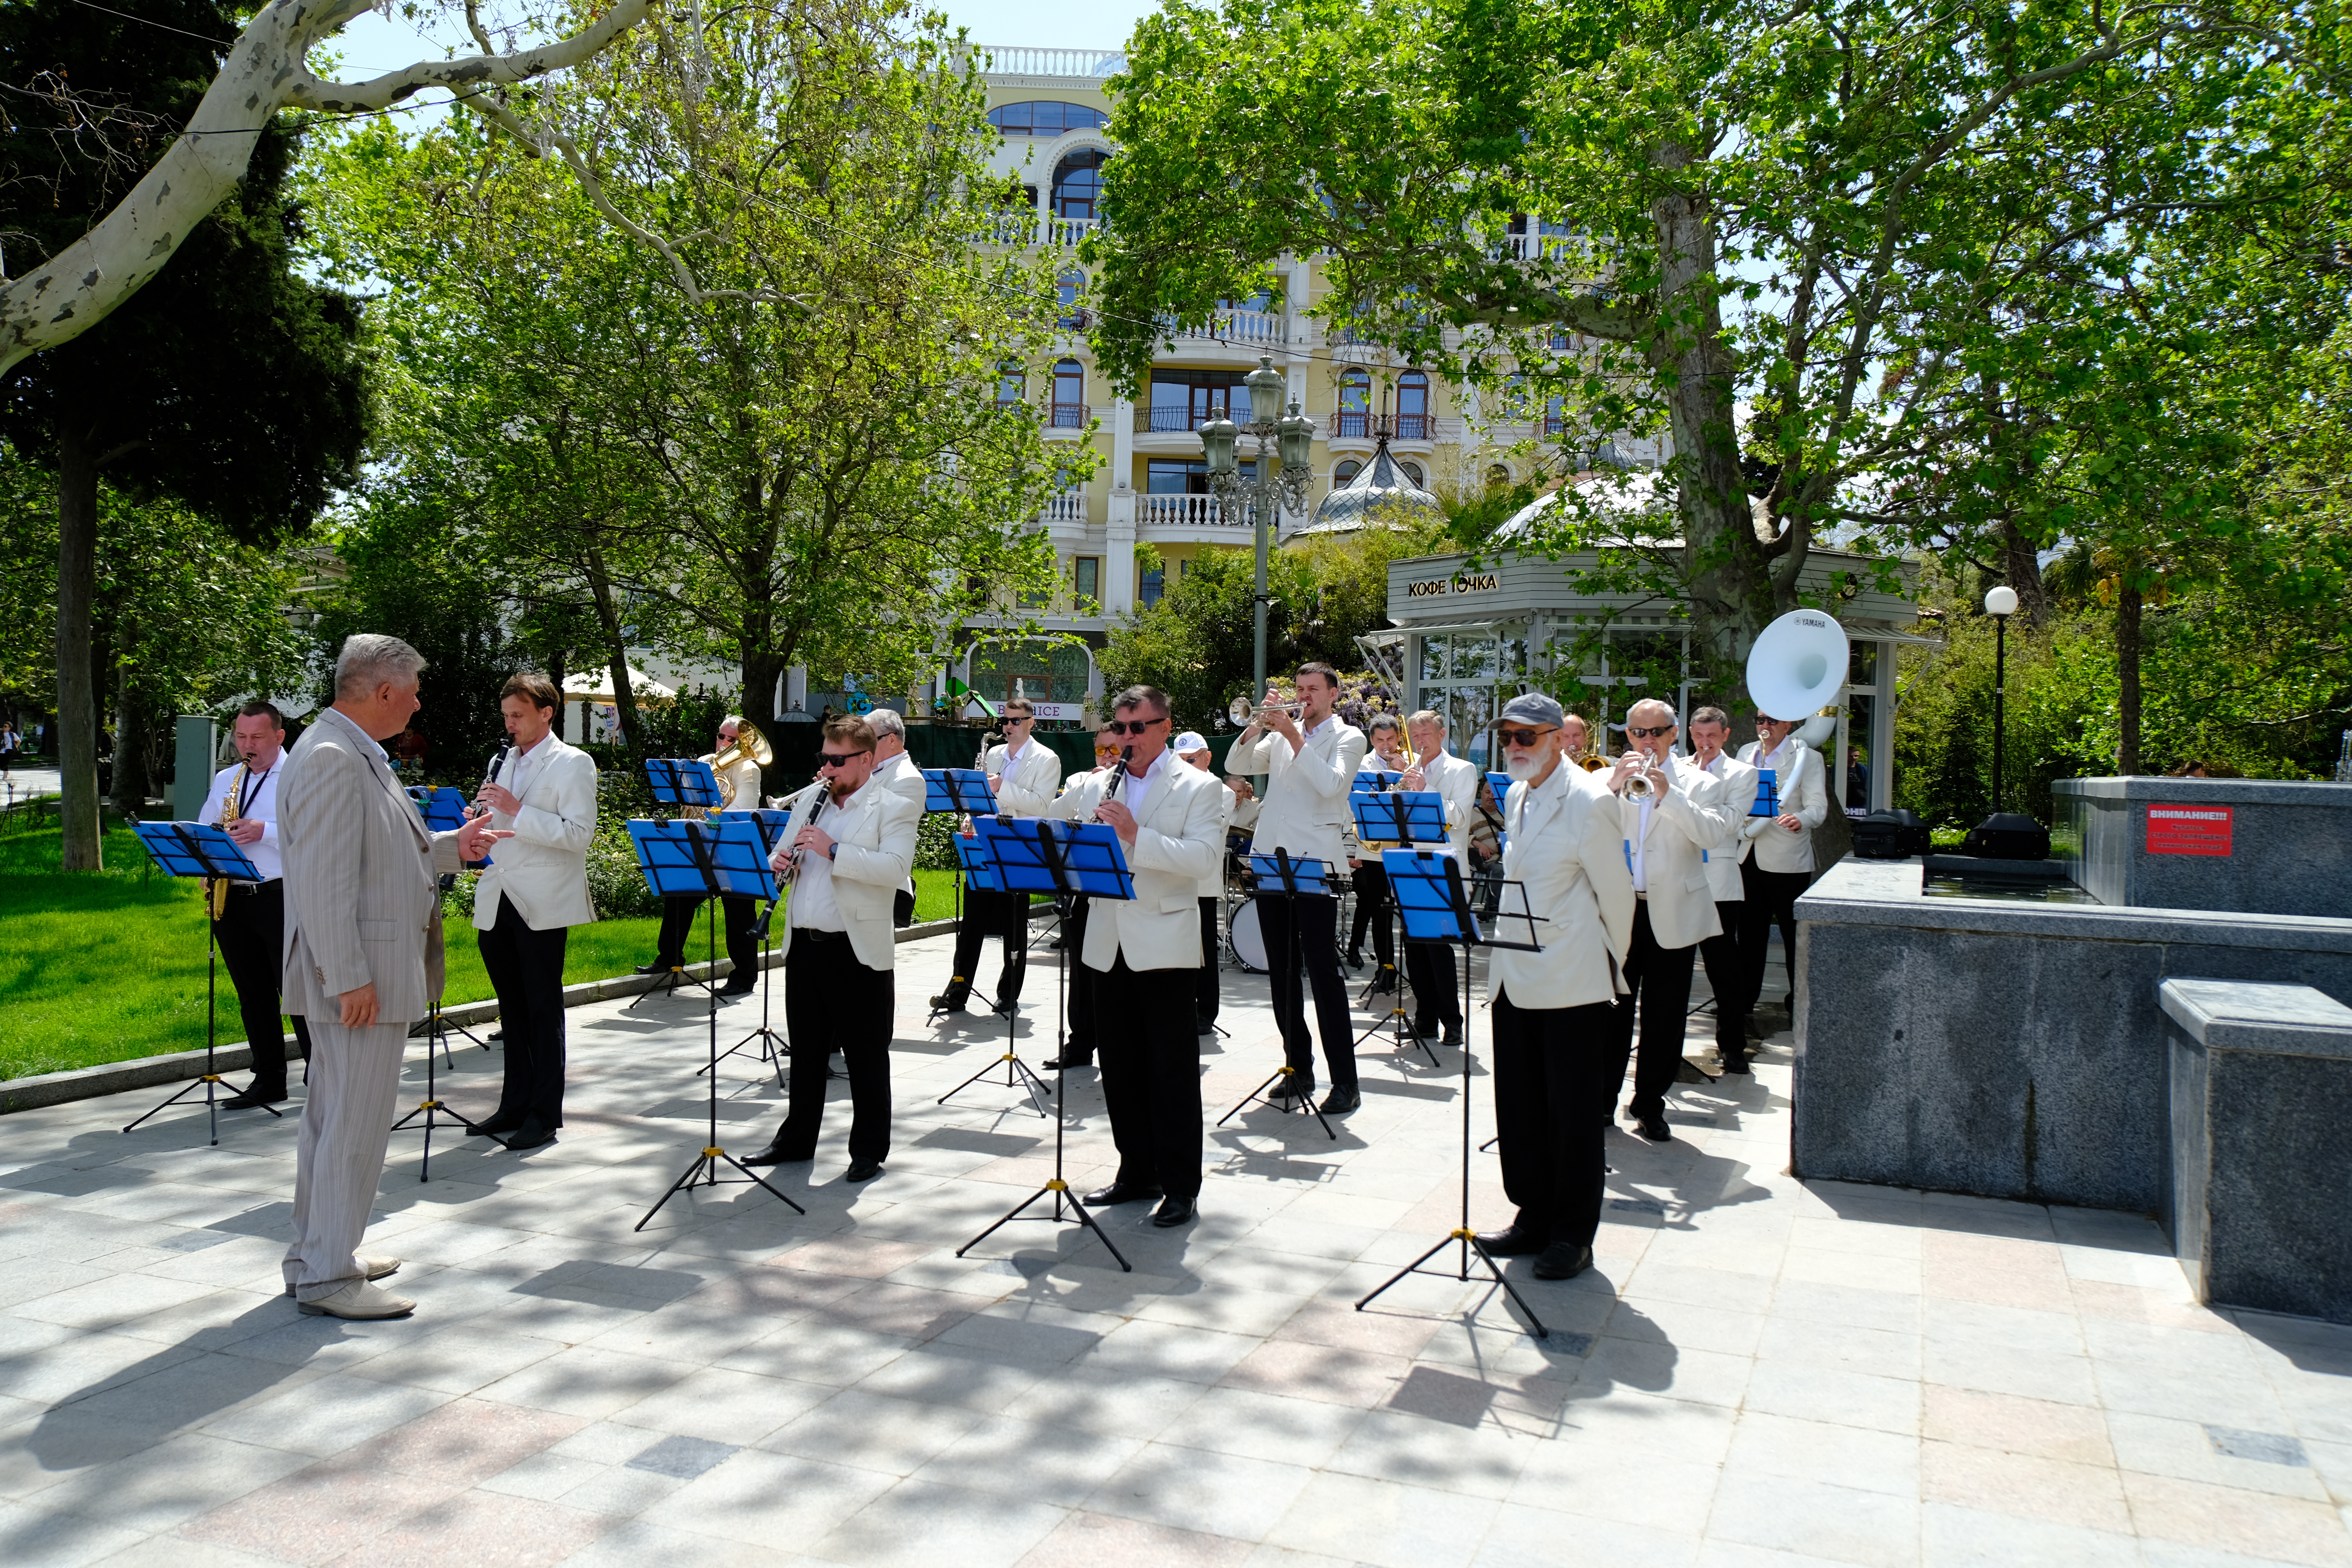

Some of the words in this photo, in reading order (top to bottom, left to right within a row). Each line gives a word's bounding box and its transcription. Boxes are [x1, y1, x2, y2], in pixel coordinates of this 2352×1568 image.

[1409, 580, 1447, 597] КОФЕ
[1802, 618, 1825, 628] YAMAHA
[2150, 810, 2227, 821] ВНИМАНИЕ!!!
